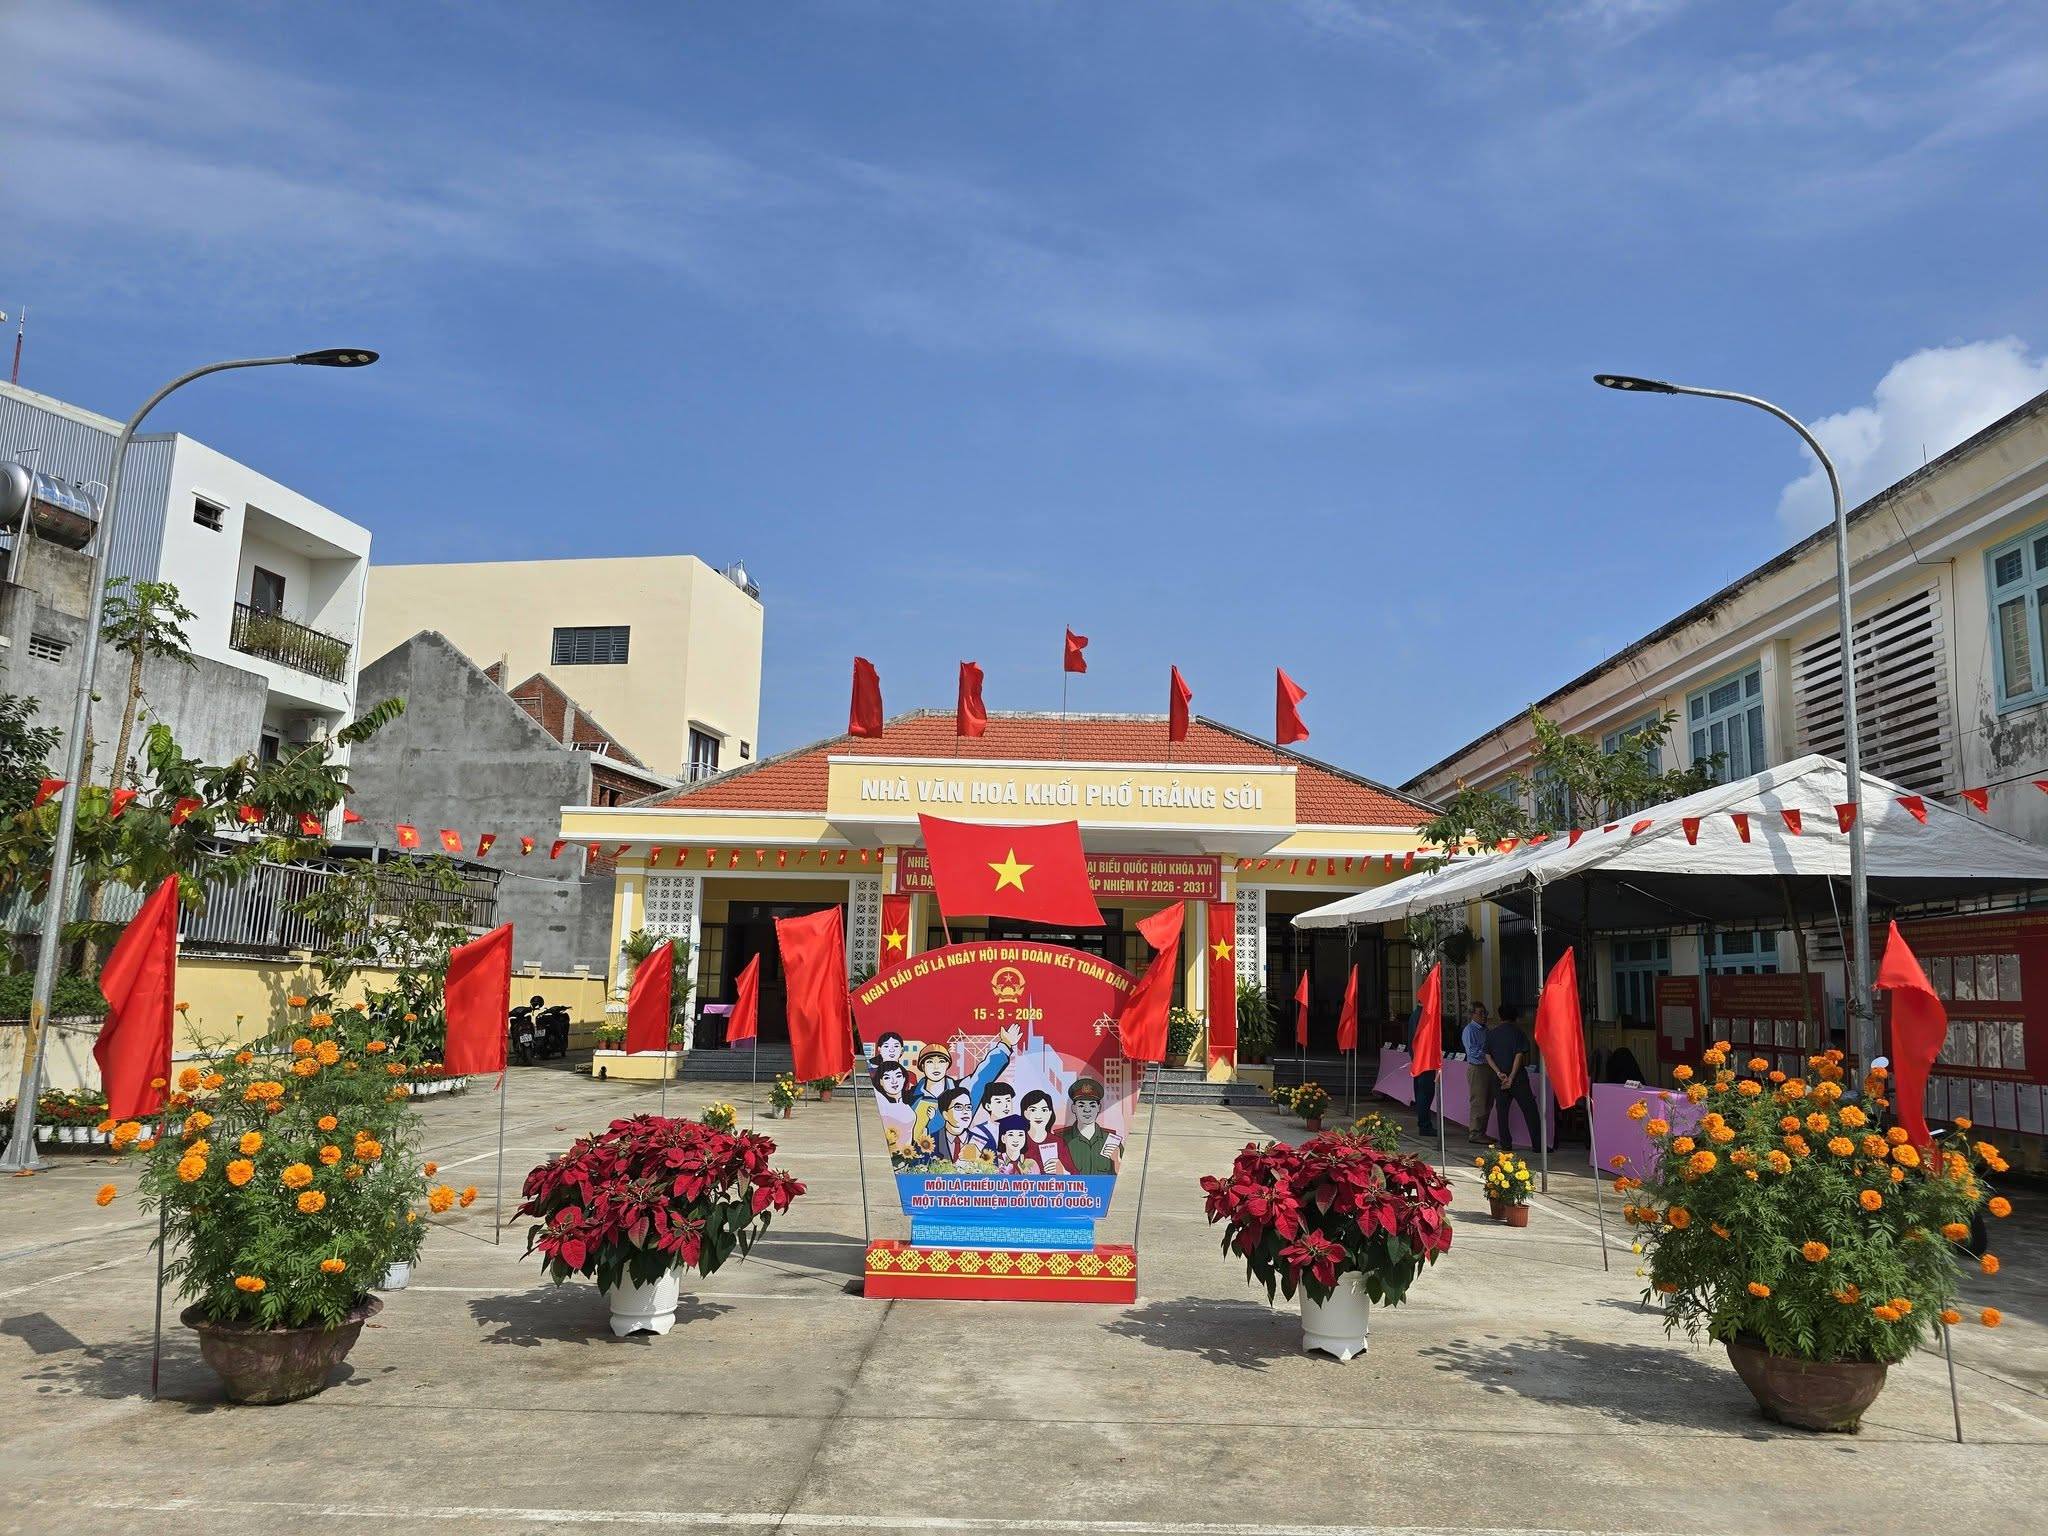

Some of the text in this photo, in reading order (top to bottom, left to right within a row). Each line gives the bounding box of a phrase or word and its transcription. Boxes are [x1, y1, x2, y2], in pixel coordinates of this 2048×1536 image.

[861, 777, 1263, 811] NHÀ VĂN HOÁ KHỐI PHỐ TRẢNG SỎI
[907, 855, 1213, 877] NHIỆ ẠI BIỂU QUỐC HỘI KHÓA XVI
[906, 872, 919, 886] VÀ
[921, 874, 935, 889] ĐẠ
[1088, 875, 1102, 890] ẤP
[1103, 877, 1135, 894] NHIỆM
[1136, 878, 1150, 892] KỲ
[1151, 880, 1175, 893] 2026
[1183, 881, 1206, 894] 2031
[1208, 882, 1213, 894] !
[861, 983, 891, 1006] NGÀY
[889, 968, 913, 989] BẦU
[913, 959, 930, 977] CỬ
[930, 955, 946, 971] LÀ
[946, 949, 977, 967] NGÀY
[979, 946, 998, 963] HỘI
[1000, 948, 1019, 963] ĐẠI
[1022, 949, 1053, 966] ĐOÀN
[1054, 952, 1076, 969] KẾT
[1077, 960, 1107, 981] TOÀN
[1105, 973, 1129, 992] DÂN
[973, 1008, 987, 1020] 15
[997, 1008, 1005, 1020] 3
[1015, 1008, 1044, 1021] 2026
[925, 1177, 1088, 1194] MỖI LÁ PHIẾU LÀ MỘT NIỀM TIN,
[912, 1192, 1101, 1210] MỘT TRÁCH NHIỆM ĐỐI VỚI TỔ QUỐC !
